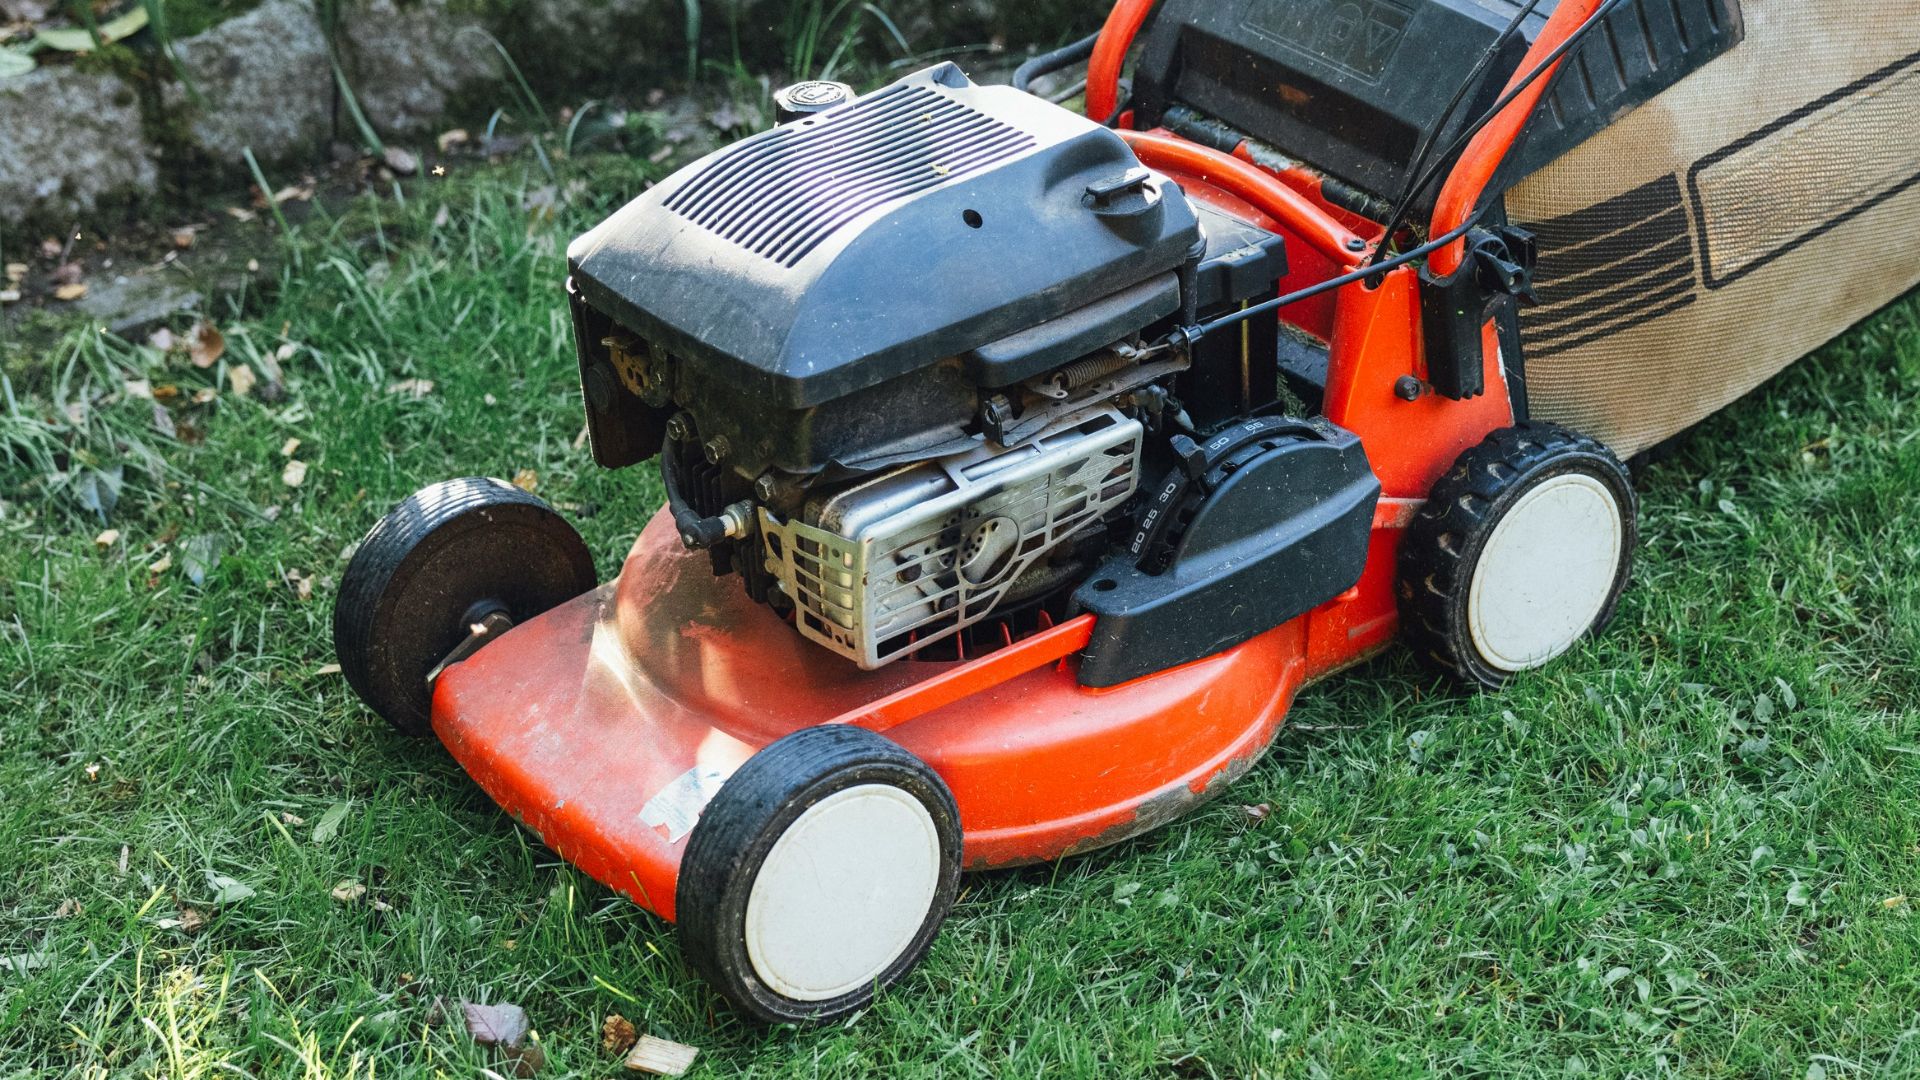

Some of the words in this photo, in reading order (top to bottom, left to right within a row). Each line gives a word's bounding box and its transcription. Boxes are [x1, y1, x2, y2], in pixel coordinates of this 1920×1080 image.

[1131, 531, 1145, 554] 20
[1143, 509, 1158, 529] 25
[1159, 483, 1177, 503] 30
[1209, 436, 1230, 450] 50
